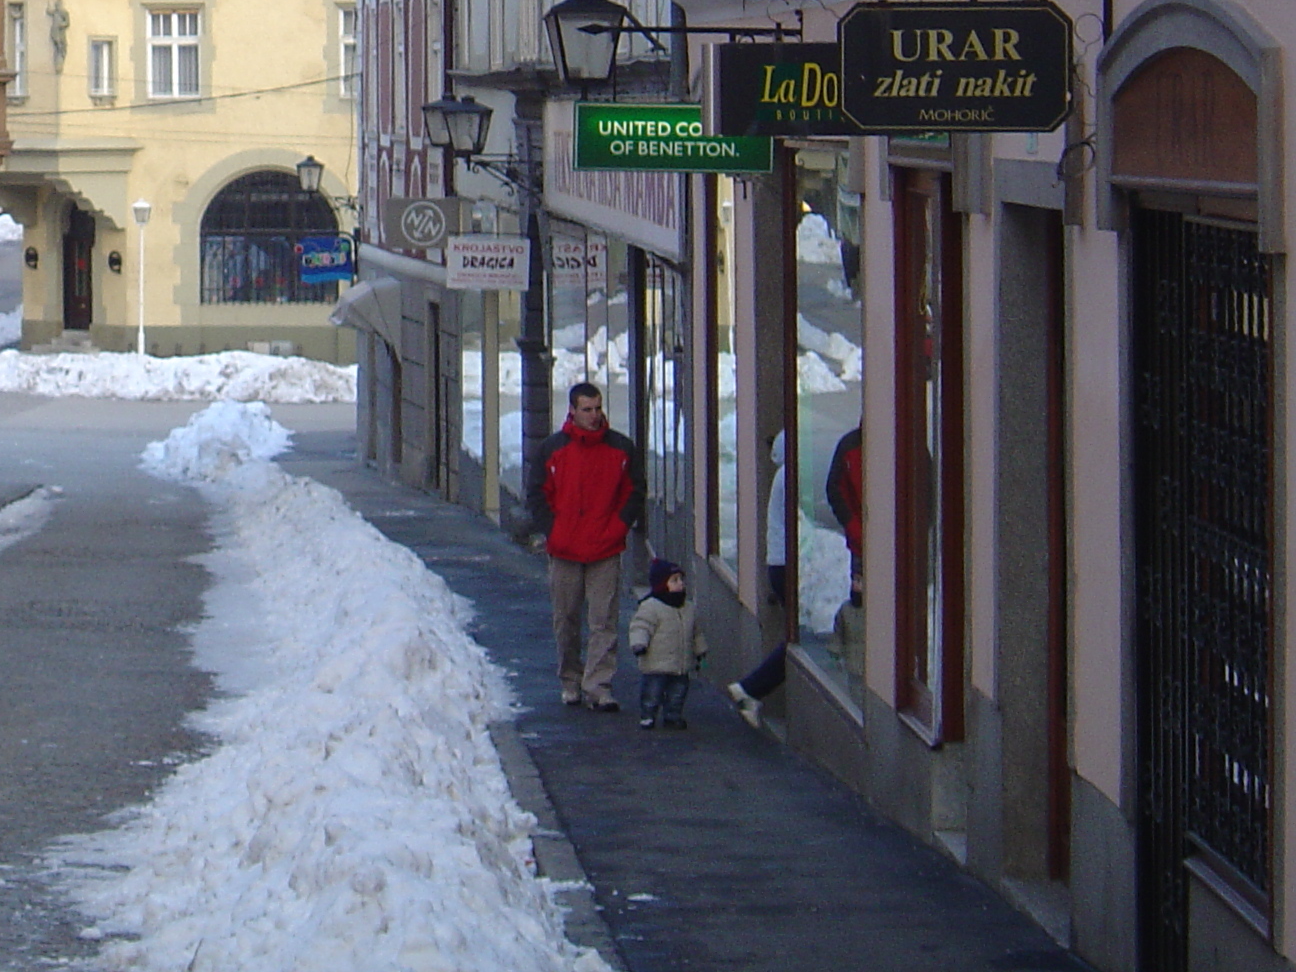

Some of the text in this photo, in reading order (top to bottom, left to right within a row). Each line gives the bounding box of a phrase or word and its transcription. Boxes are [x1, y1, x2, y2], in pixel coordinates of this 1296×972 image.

[890, 28, 1023, 62] URAR
[873, 69, 1038, 98] zlati nakit
[775, 109, 845, 122] BOUTI
[598, 120, 671, 137] UNITED
[610, 140, 635, 156] OF
[462, 256, 515, 270] DRAGICA
